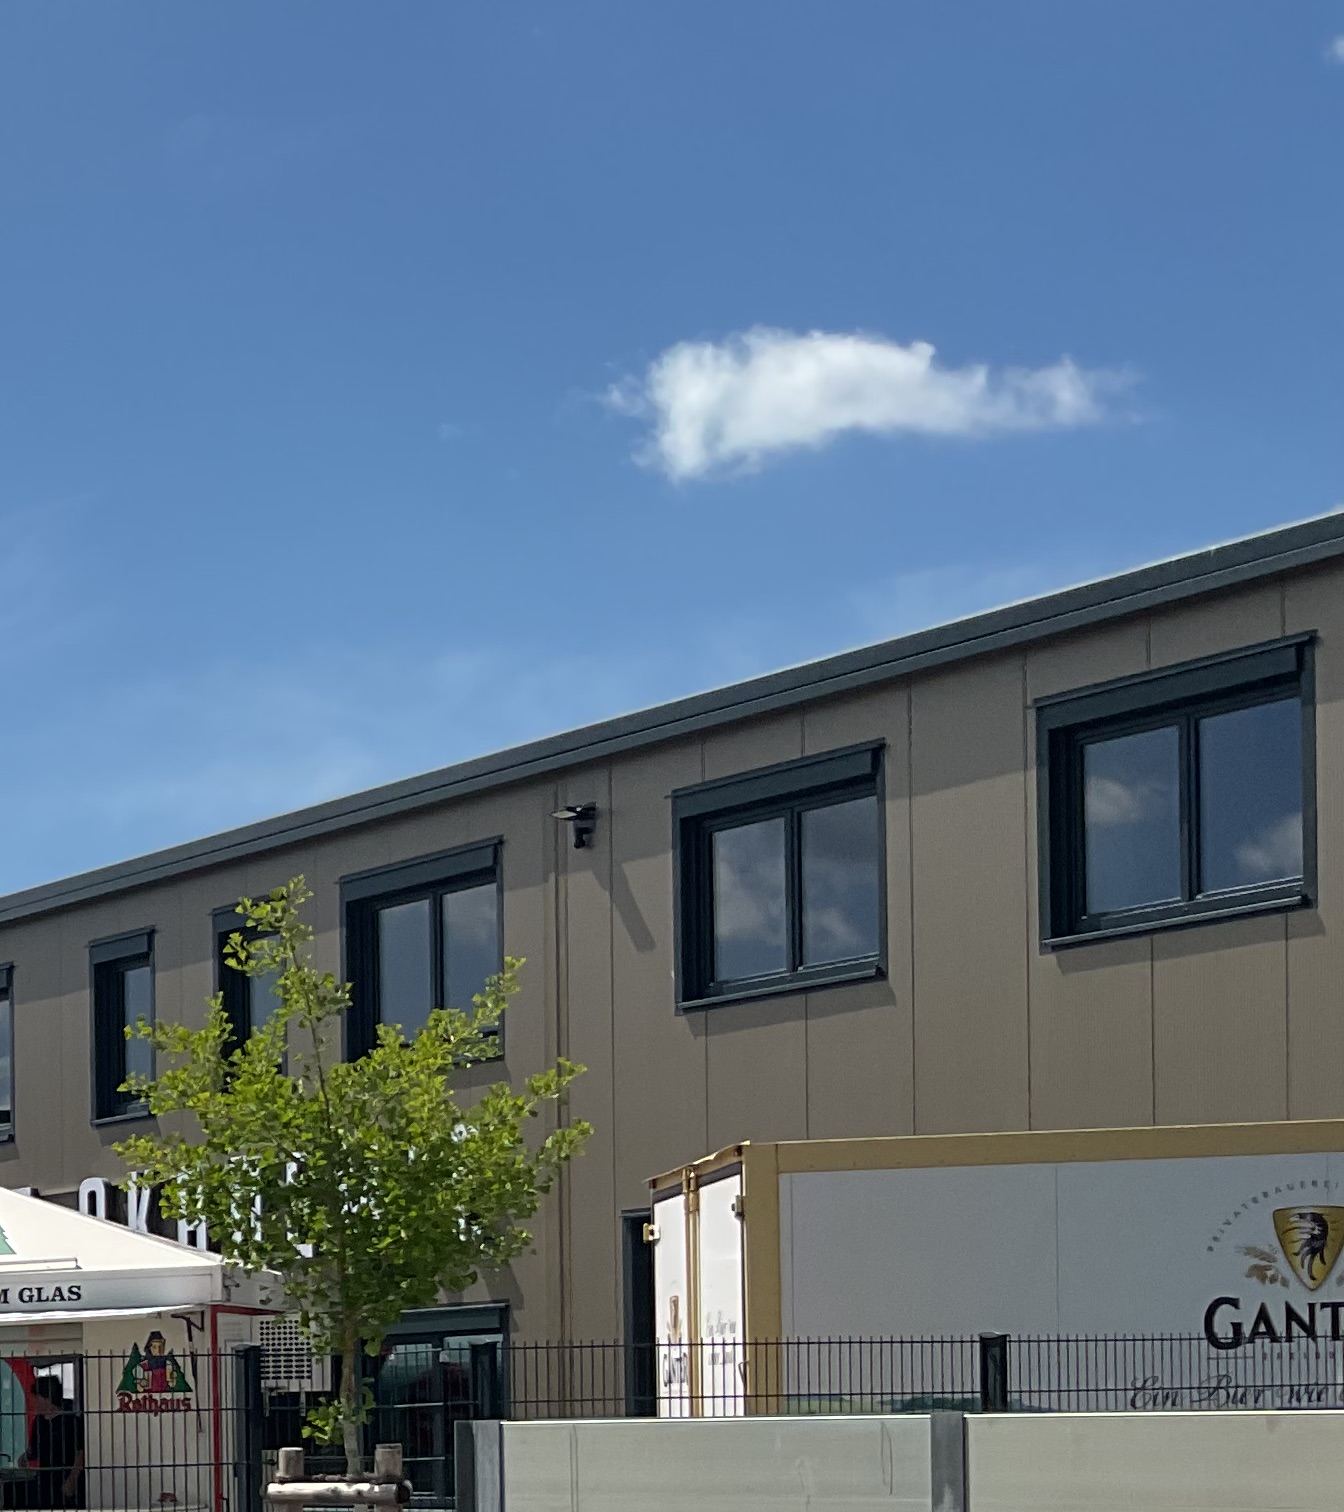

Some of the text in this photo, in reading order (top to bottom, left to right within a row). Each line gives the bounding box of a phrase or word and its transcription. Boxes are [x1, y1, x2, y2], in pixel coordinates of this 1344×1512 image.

[17, 1285, 83, 1304] GLAS
[1203, 1296, 1344, 1350] GANT
[115, 1391, 193, 1418] Rothaus
